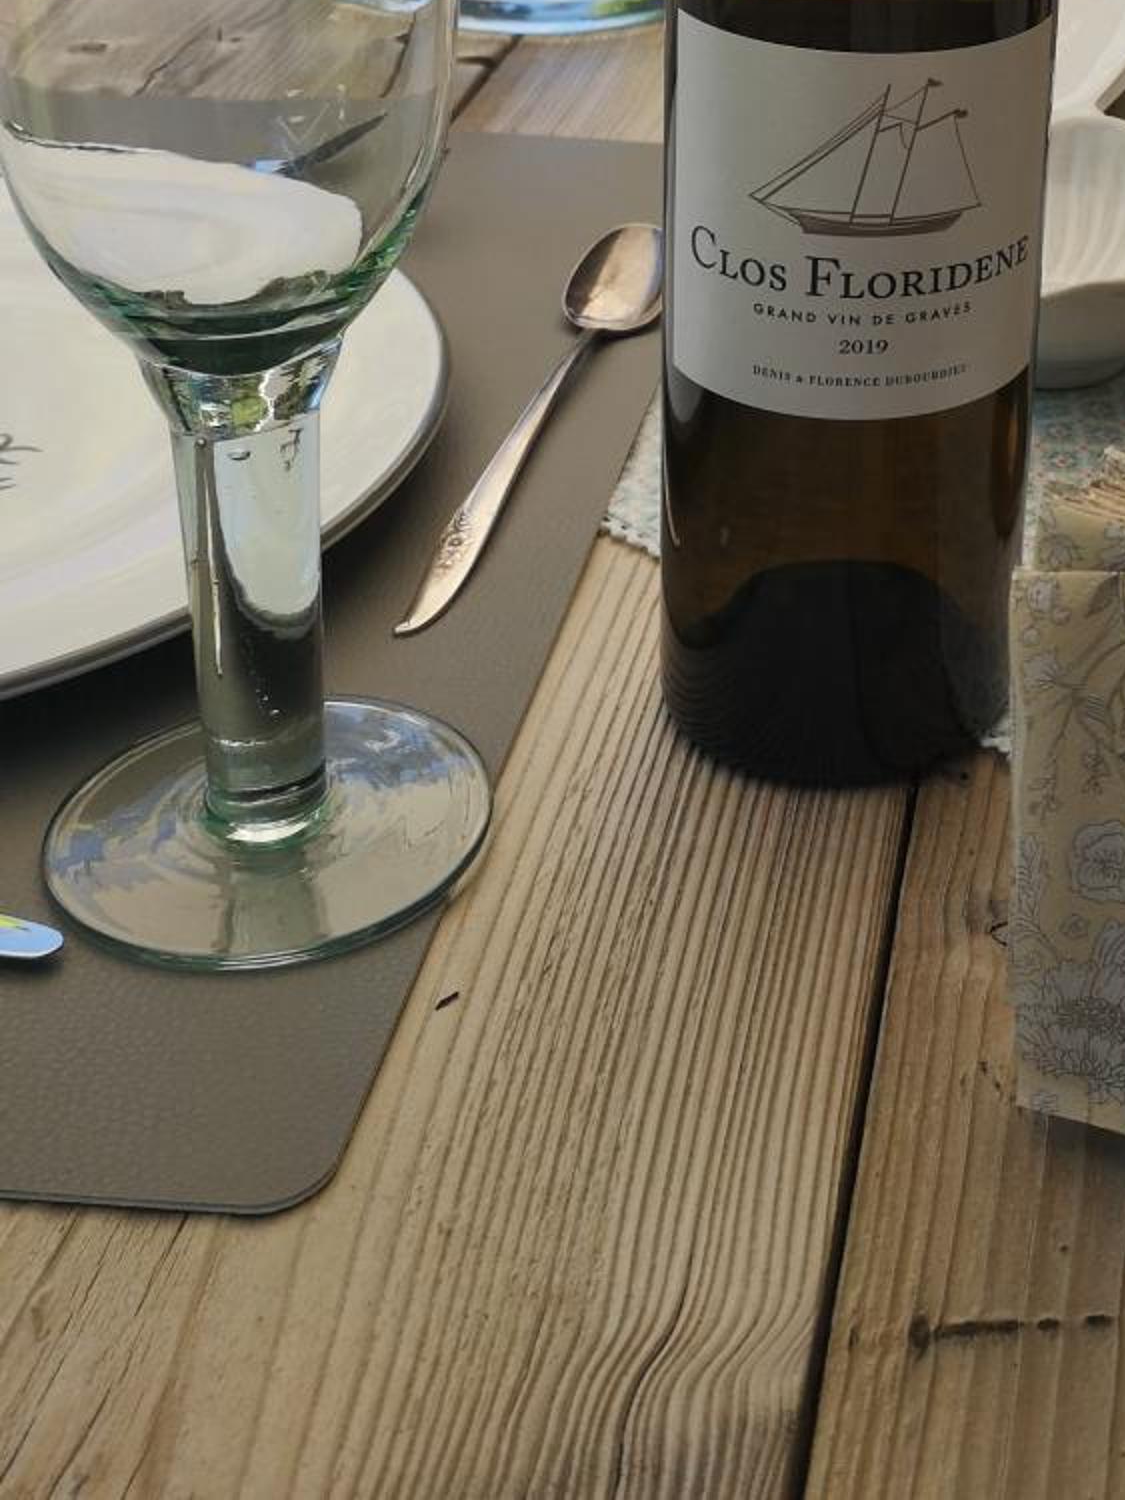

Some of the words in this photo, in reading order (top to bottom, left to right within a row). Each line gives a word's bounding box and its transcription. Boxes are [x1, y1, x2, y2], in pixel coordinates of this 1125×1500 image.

[690, 225, 788, 292] CLOS
[805, 235, 1030, 300] FLORIDENE
[753, 303, 817, 324] GRAND
[827, 314, 861, 326] VIN
[872, 314, 896, 326] DE
[905, 301, 971, 324] GRAVES
[839, 339, 889, 355] 2019
[752, 364, 791, 381] DENIS
[809, 374, 881, 388] FLORENCE
